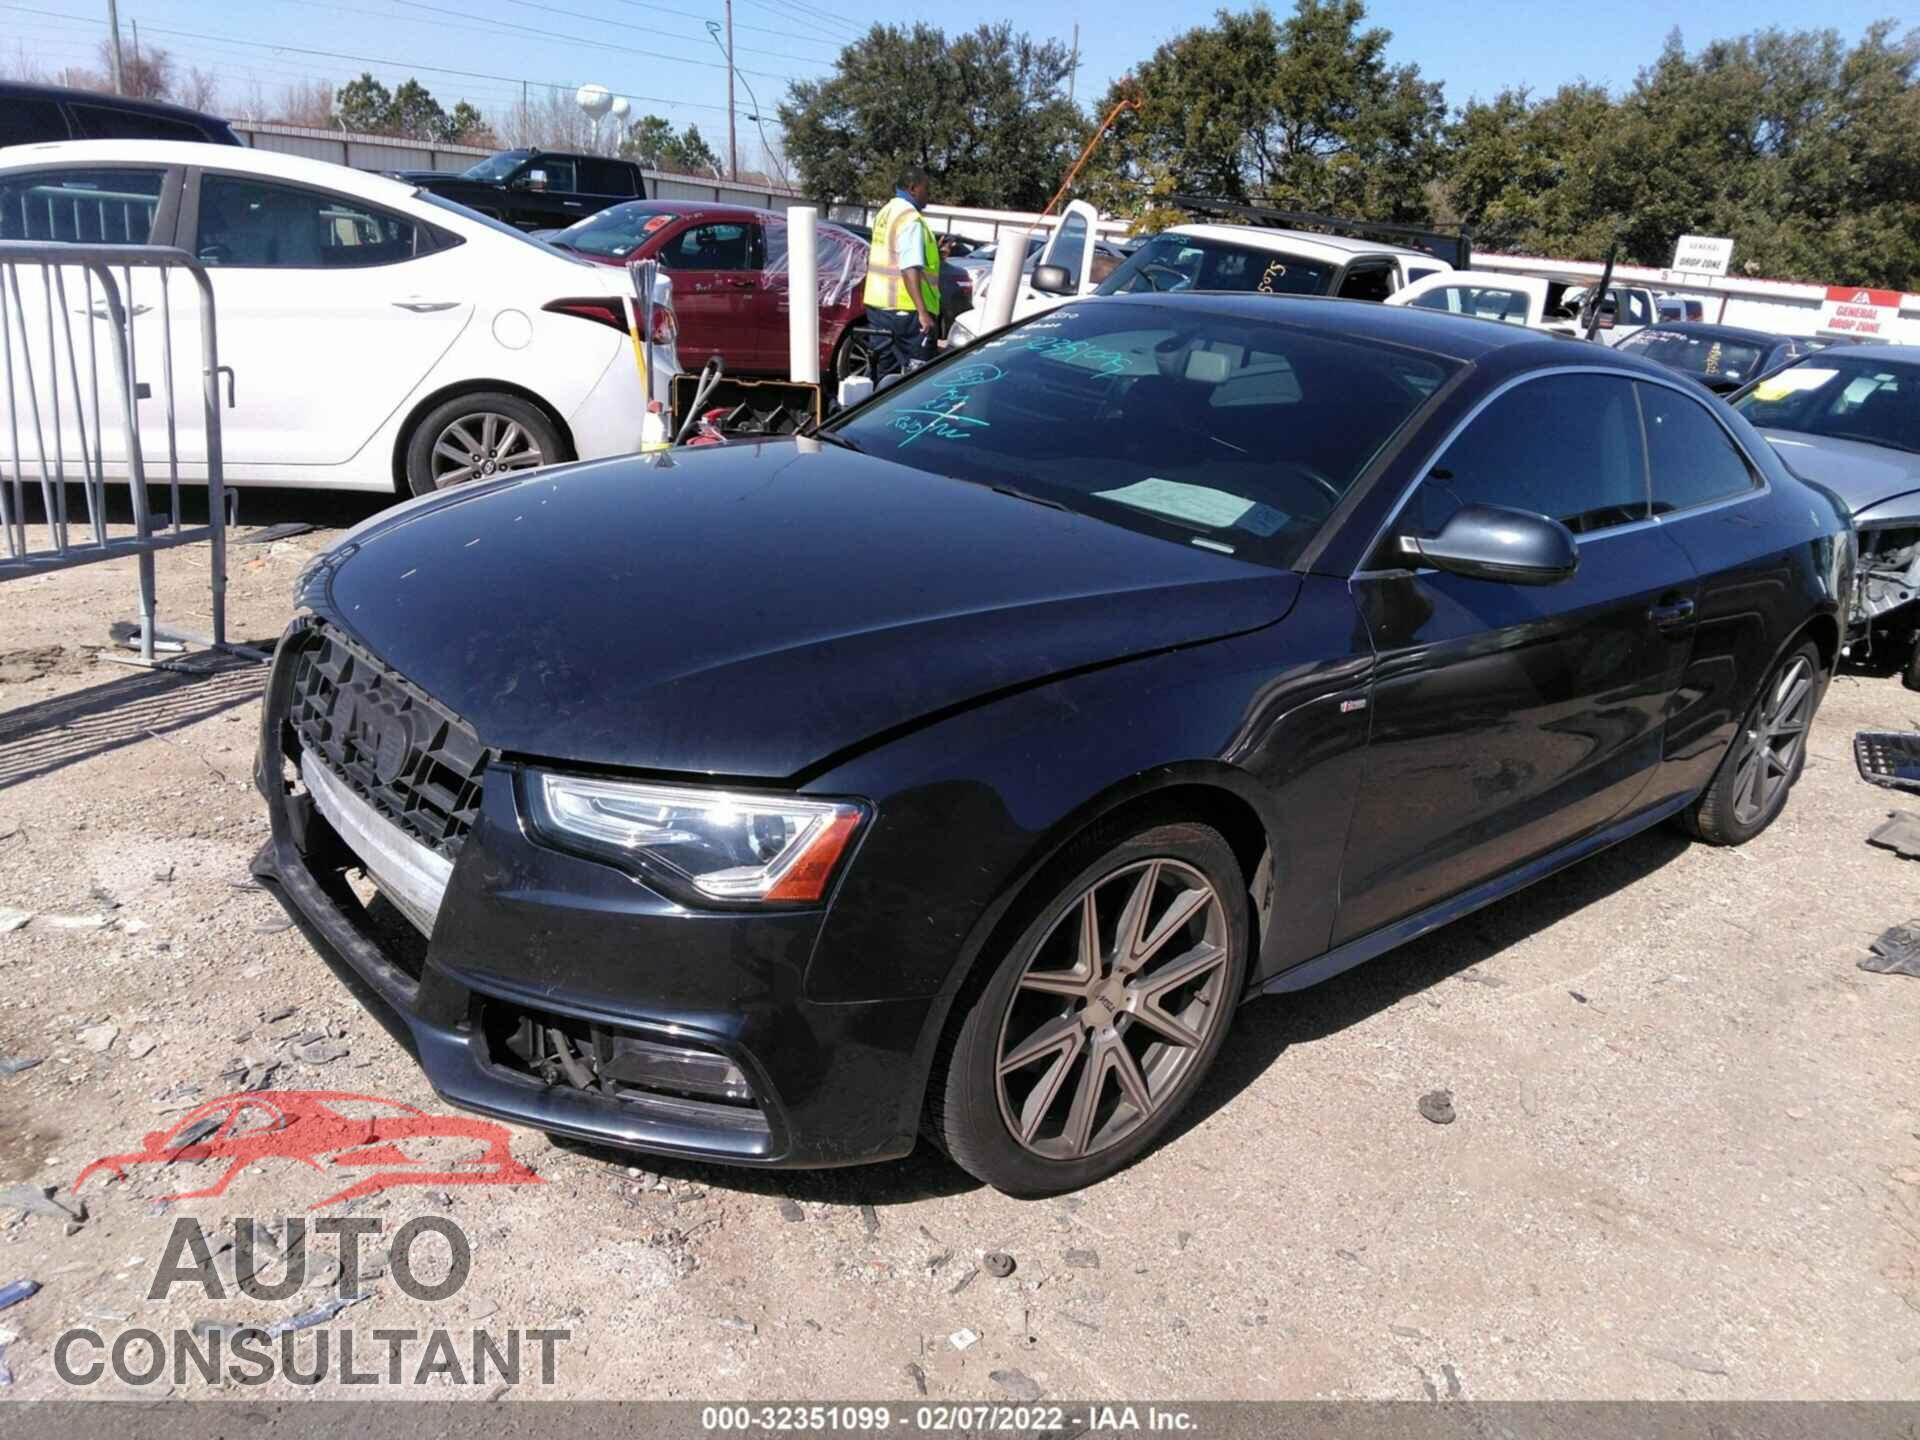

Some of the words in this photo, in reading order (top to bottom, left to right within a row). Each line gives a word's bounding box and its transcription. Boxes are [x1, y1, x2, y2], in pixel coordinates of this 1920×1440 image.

[1679, 256, 1701, 266] DROP
[1701, 258, 1721, 269] ZONE
[1836, 306, 1878, 319] GENERAL
[1828, 318, 1856, 329] DROP
[1856, 321, 1881, 334] ZONE
